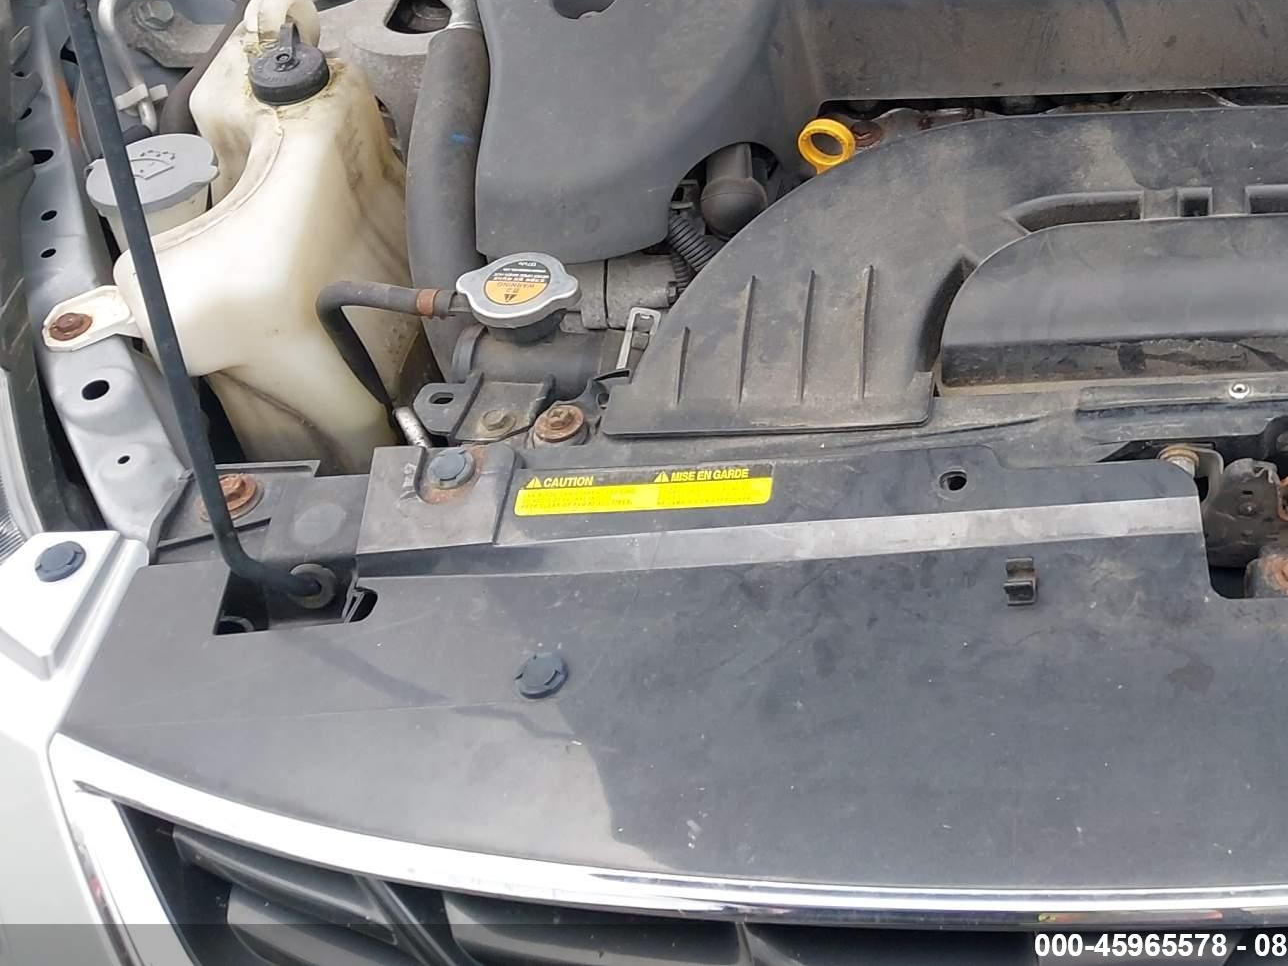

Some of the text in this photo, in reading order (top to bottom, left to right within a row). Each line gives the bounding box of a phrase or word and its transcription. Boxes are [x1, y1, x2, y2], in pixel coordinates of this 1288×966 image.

[543, 475, 595, 488] CAUTION
[670, 468, 750, 483] MISE EN GARDE
